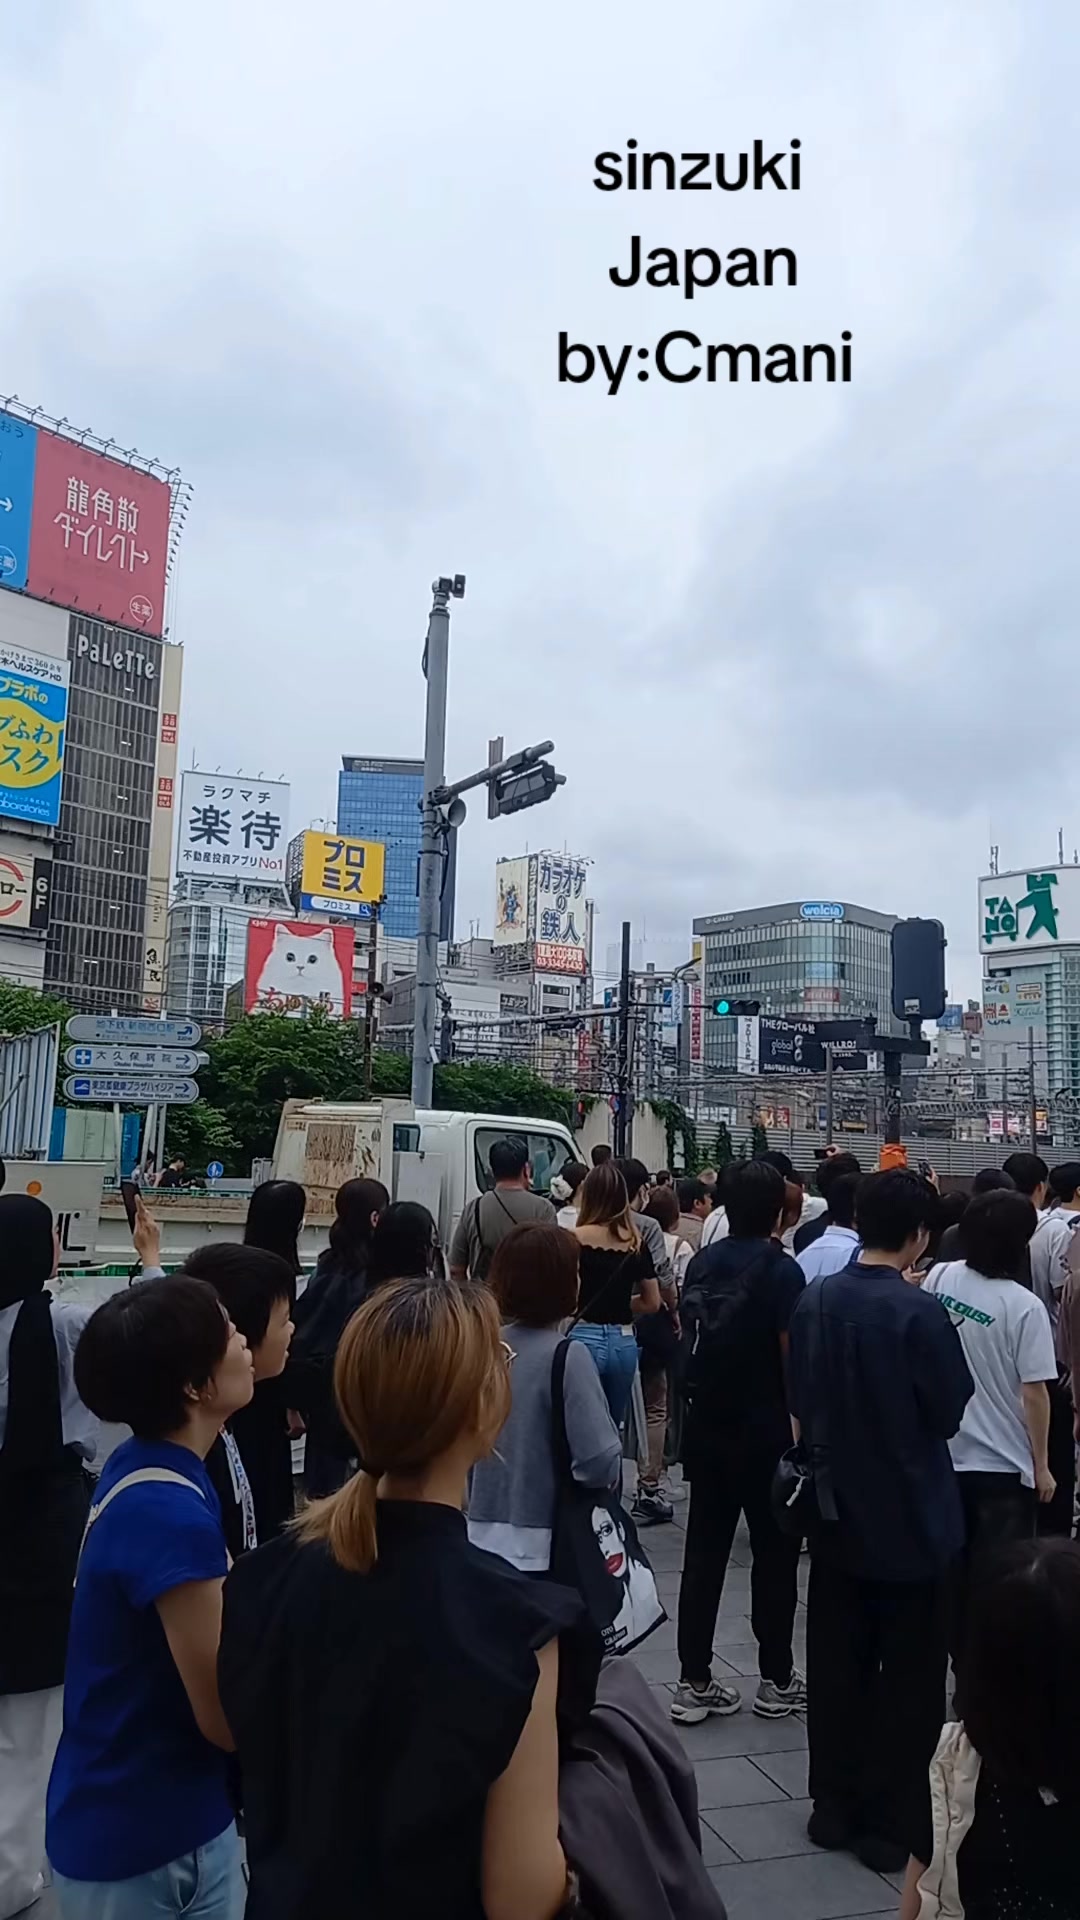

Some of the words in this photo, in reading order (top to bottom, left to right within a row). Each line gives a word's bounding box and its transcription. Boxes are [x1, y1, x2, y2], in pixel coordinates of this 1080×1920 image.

[66, 476, 139, 535] 龍角散
[54, 512, 150, 573] ダイレクト
[203, 785, 271, 804] ラクマチ
[189, 804, 281, 851] 楽待
[540, 857, 586, 899] カラオケ
[556, 895, 567, 914] の
[541, 907, 581, 945] 鉄人
[771, 1039, 793, 1055] global
